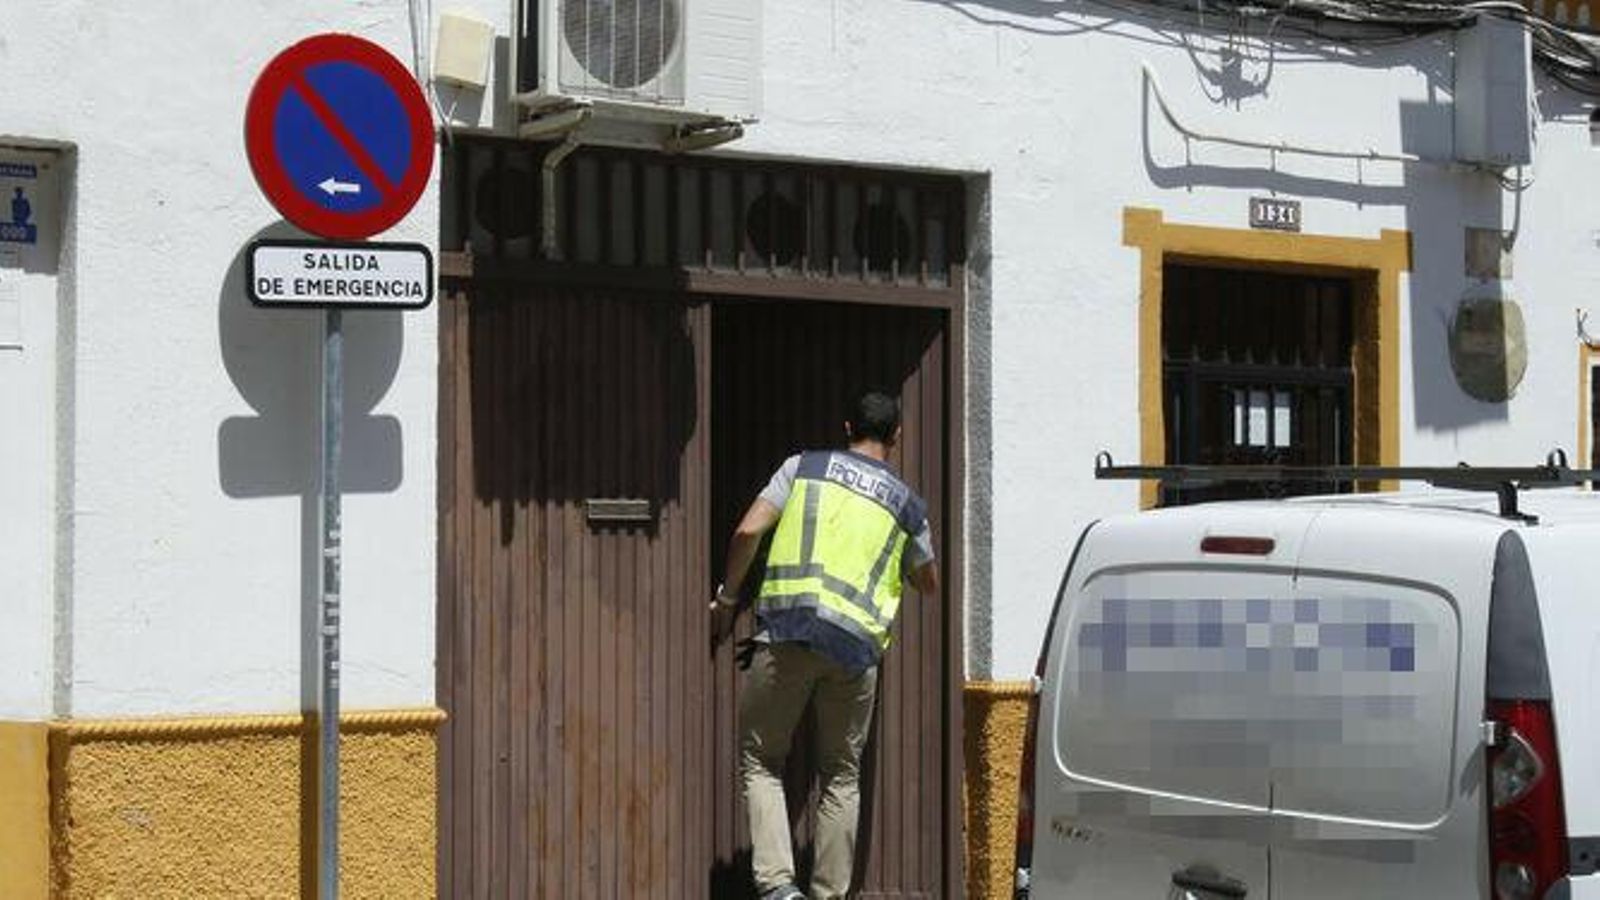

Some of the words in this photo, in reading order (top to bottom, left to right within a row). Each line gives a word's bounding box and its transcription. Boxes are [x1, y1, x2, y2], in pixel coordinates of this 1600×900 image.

[304, 253, 380, 271] SALIDA
[257, 277, 285, 295] DE
[293, 278, 423, 297] EMERGENCIA
[829, 461, 901, 508] POLICIA
